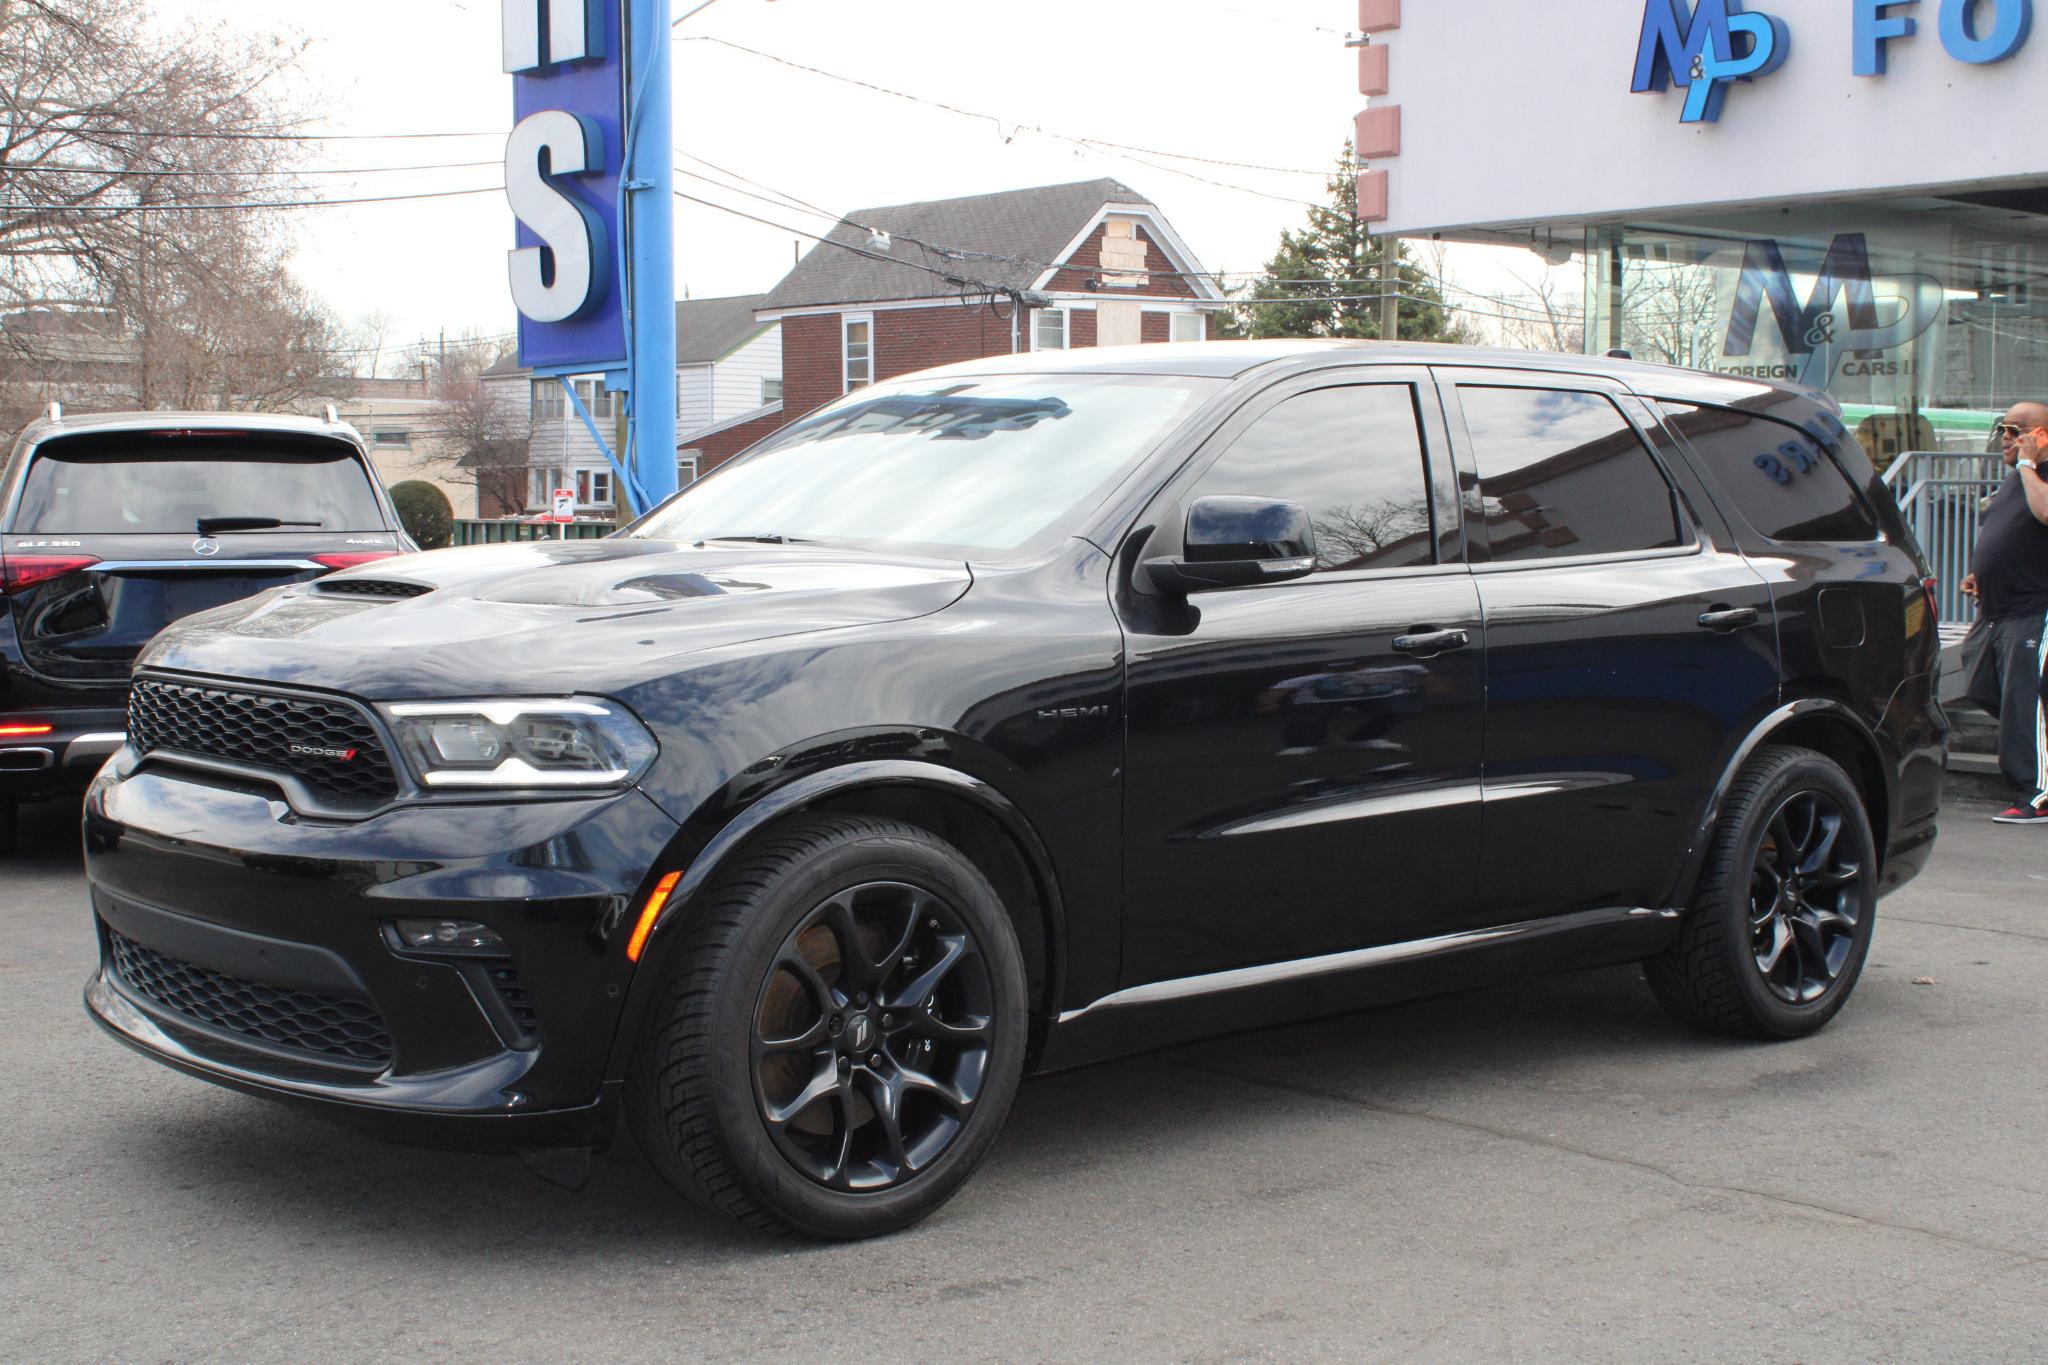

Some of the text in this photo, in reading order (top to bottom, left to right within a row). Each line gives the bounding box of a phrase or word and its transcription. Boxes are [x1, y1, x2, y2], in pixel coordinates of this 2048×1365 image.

[1841, 361, 1898, 377] CARS
[1037, 704, 1109, 719] HEMI
[290, 745, 347, 757] DODGE
